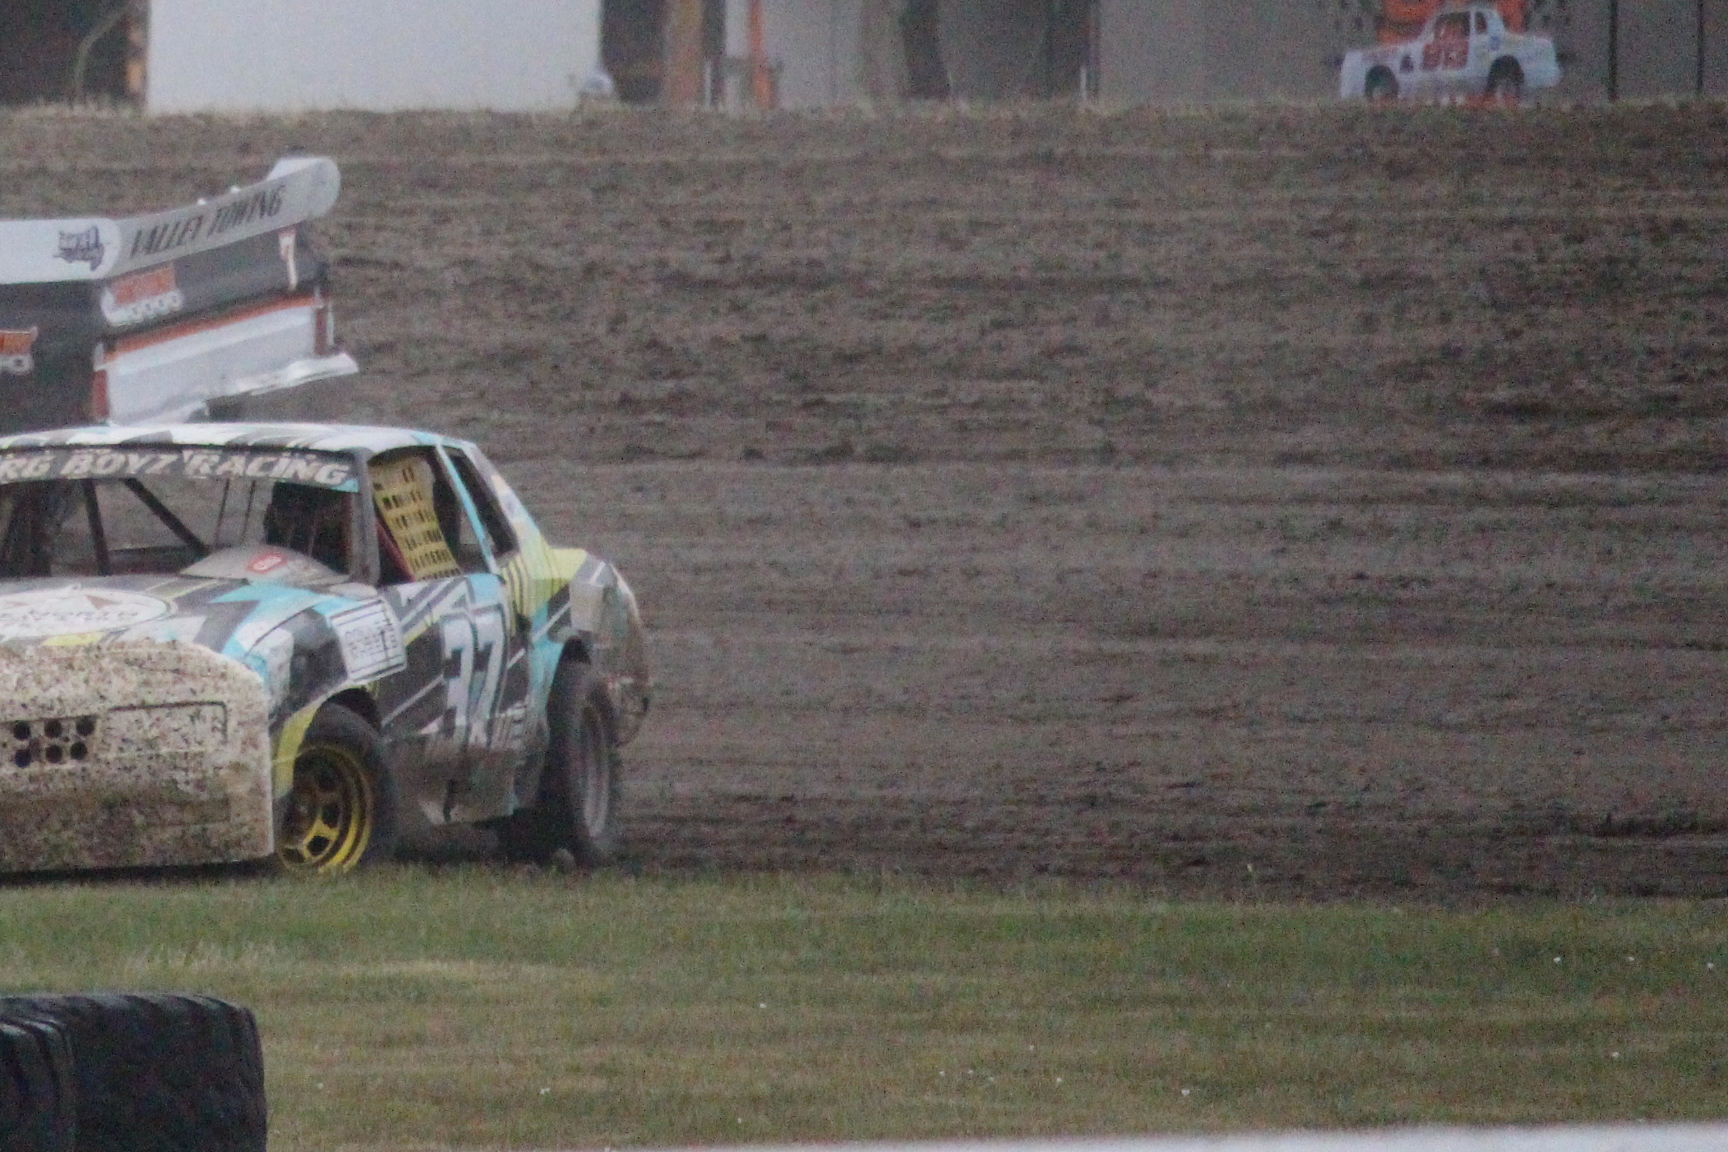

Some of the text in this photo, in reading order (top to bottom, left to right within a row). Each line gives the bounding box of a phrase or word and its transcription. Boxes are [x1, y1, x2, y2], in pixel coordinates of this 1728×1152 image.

[129, 213, 205, 260] VALLEY
[206, 184, 286, 239] TOWING
[60, 450, 178, 477] BOYZ
[184, 451, 351, 486] RACING
